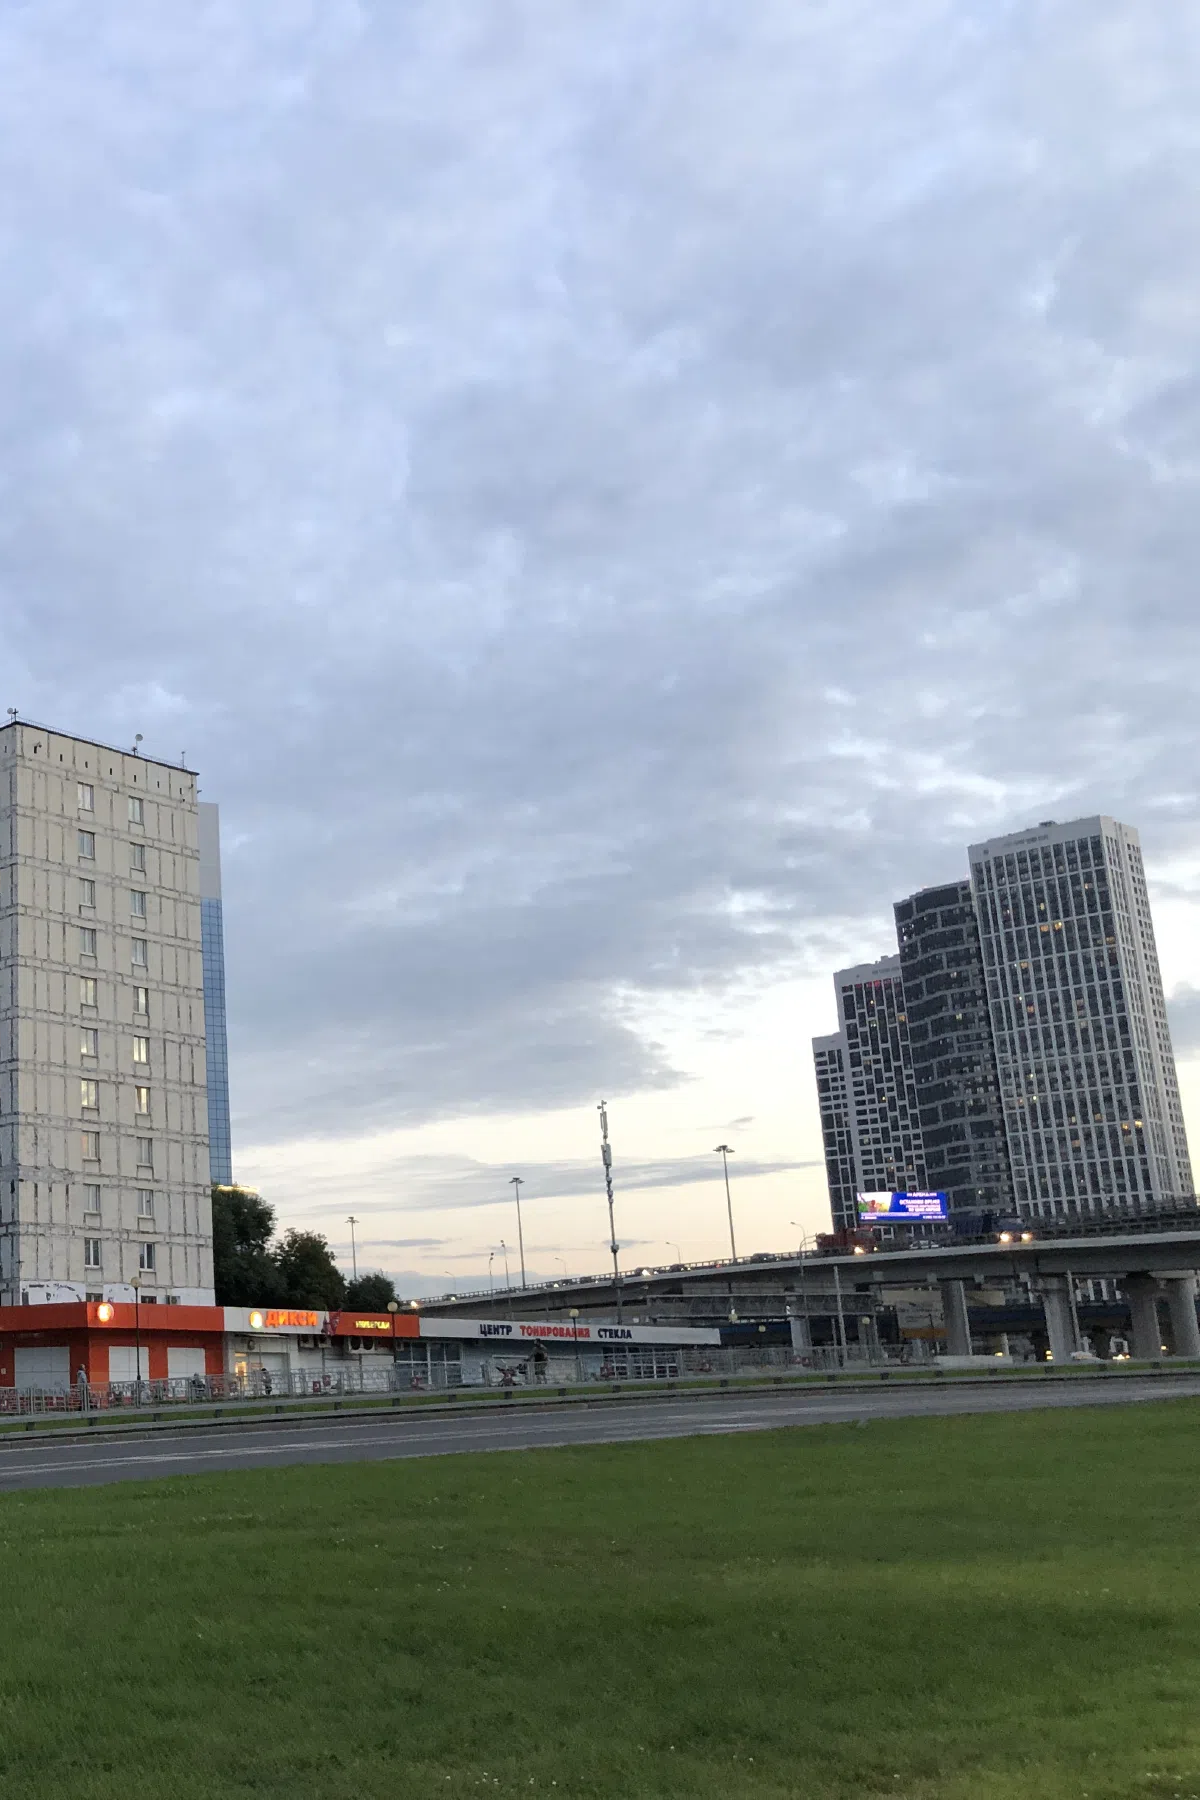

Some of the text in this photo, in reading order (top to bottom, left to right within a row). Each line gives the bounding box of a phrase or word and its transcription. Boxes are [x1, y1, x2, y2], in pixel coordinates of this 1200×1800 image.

[265, 1310, 317, 1328] ДИКСИ
[480, 1324, 633, 1339] ЦЕНТР ТОНИРОВАНИЯ СТЕКЛА
